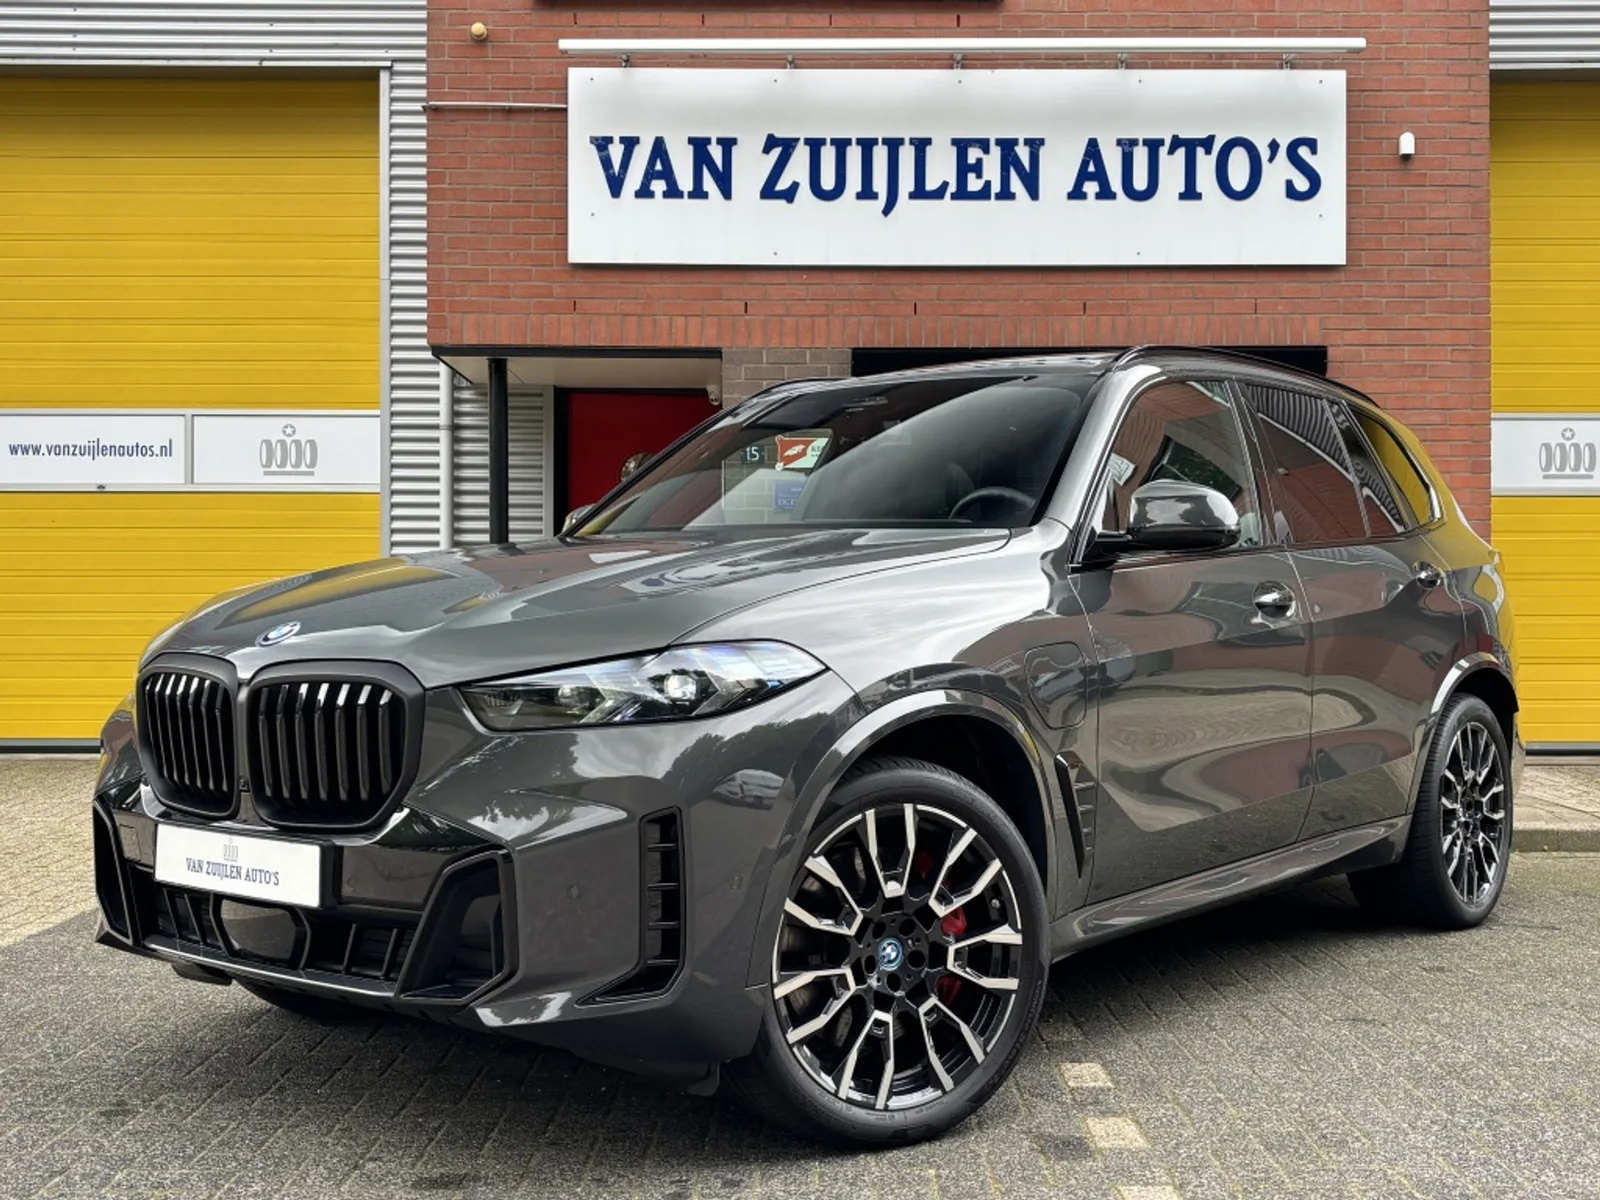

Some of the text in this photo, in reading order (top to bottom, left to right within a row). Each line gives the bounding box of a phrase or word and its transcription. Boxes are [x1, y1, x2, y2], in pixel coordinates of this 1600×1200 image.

[589, 133, 1322, 217] VAN ZUIJLEN AUTO'S
[9, 438, 173, 460] www.vanzuijlenautos.nl
[745, 447, 760, 461] 15
[186, 857, 280, 886] VAN ZUIJLEN AUTO'S
